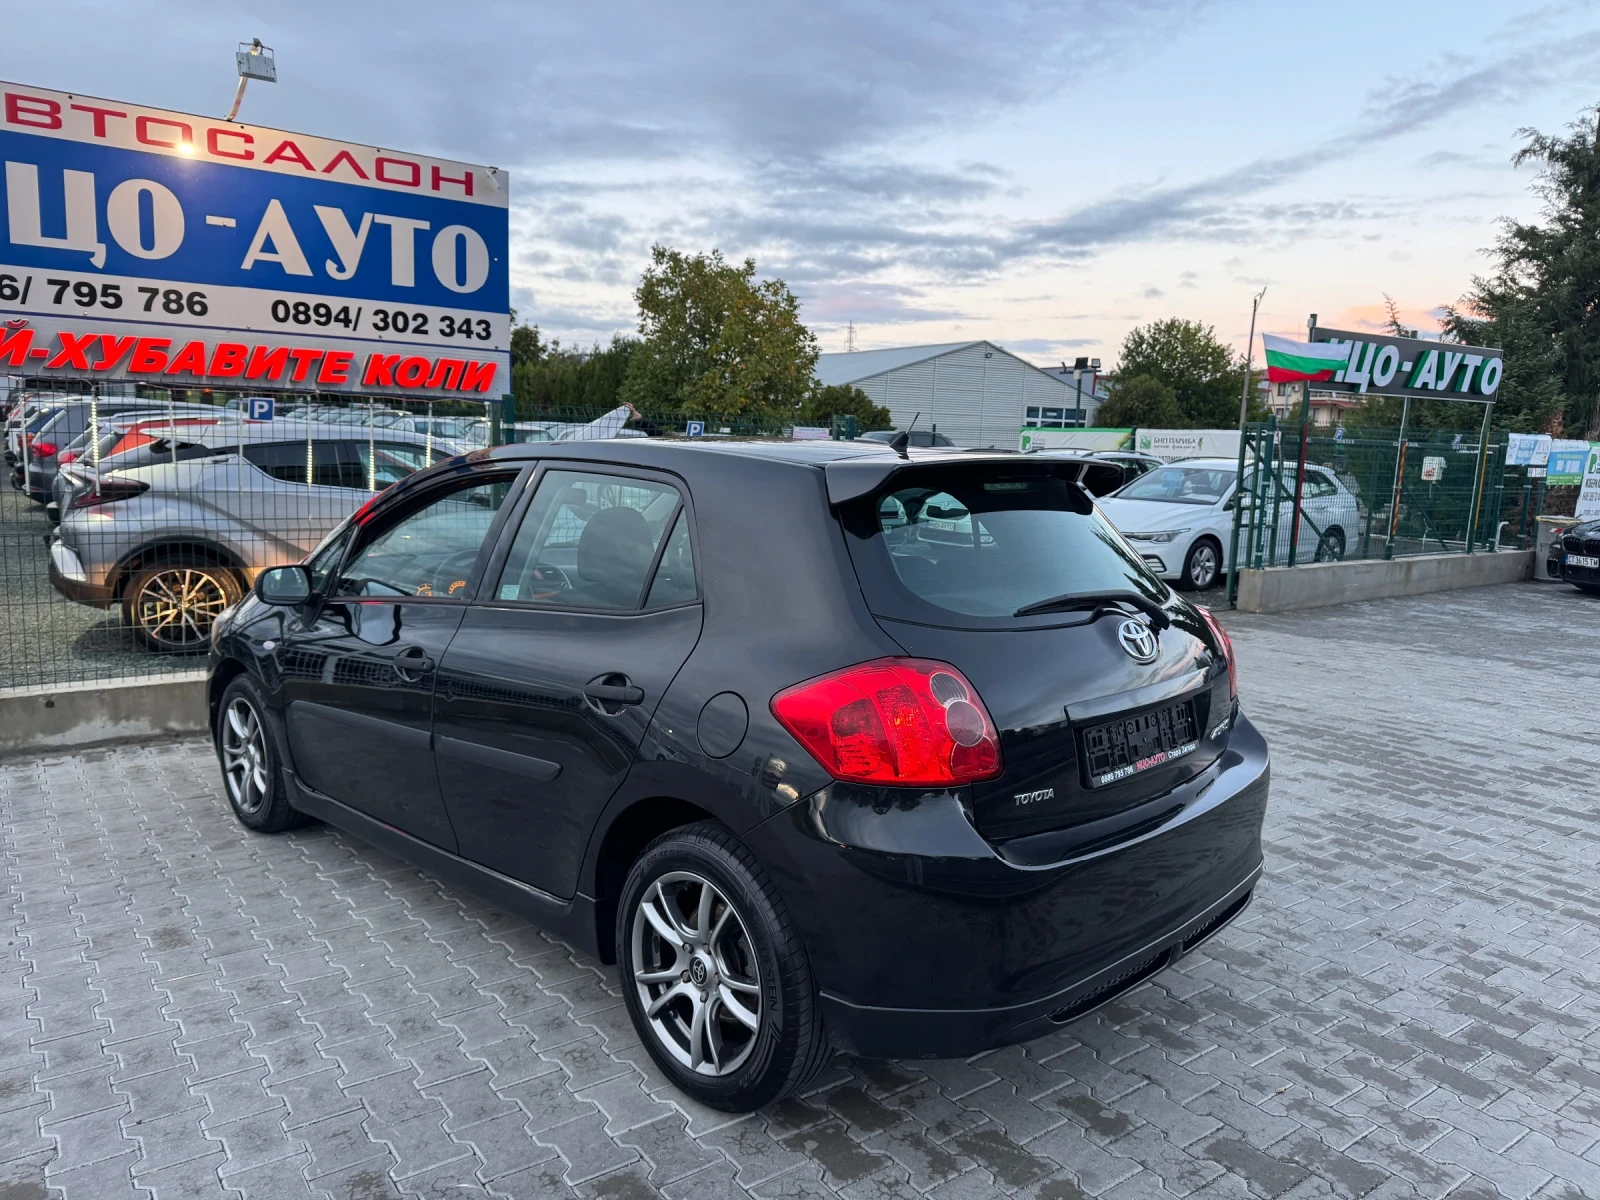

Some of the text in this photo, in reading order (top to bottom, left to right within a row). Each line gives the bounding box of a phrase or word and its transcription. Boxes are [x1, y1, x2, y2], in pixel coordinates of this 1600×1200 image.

[5, 92, 474, 196] ВТОСАЛОН
[46, 278, 123, 309] 795
[137, 287, 209, 316] 786
[271, 299, 492, 341] 0894/ 302 343
[362, 352, 497, 392] КОЛИ
[253, 401, 269, 418] P
[690, 424, 701, 436] P
[1014, 788, 1055, 805] TOYOTA
